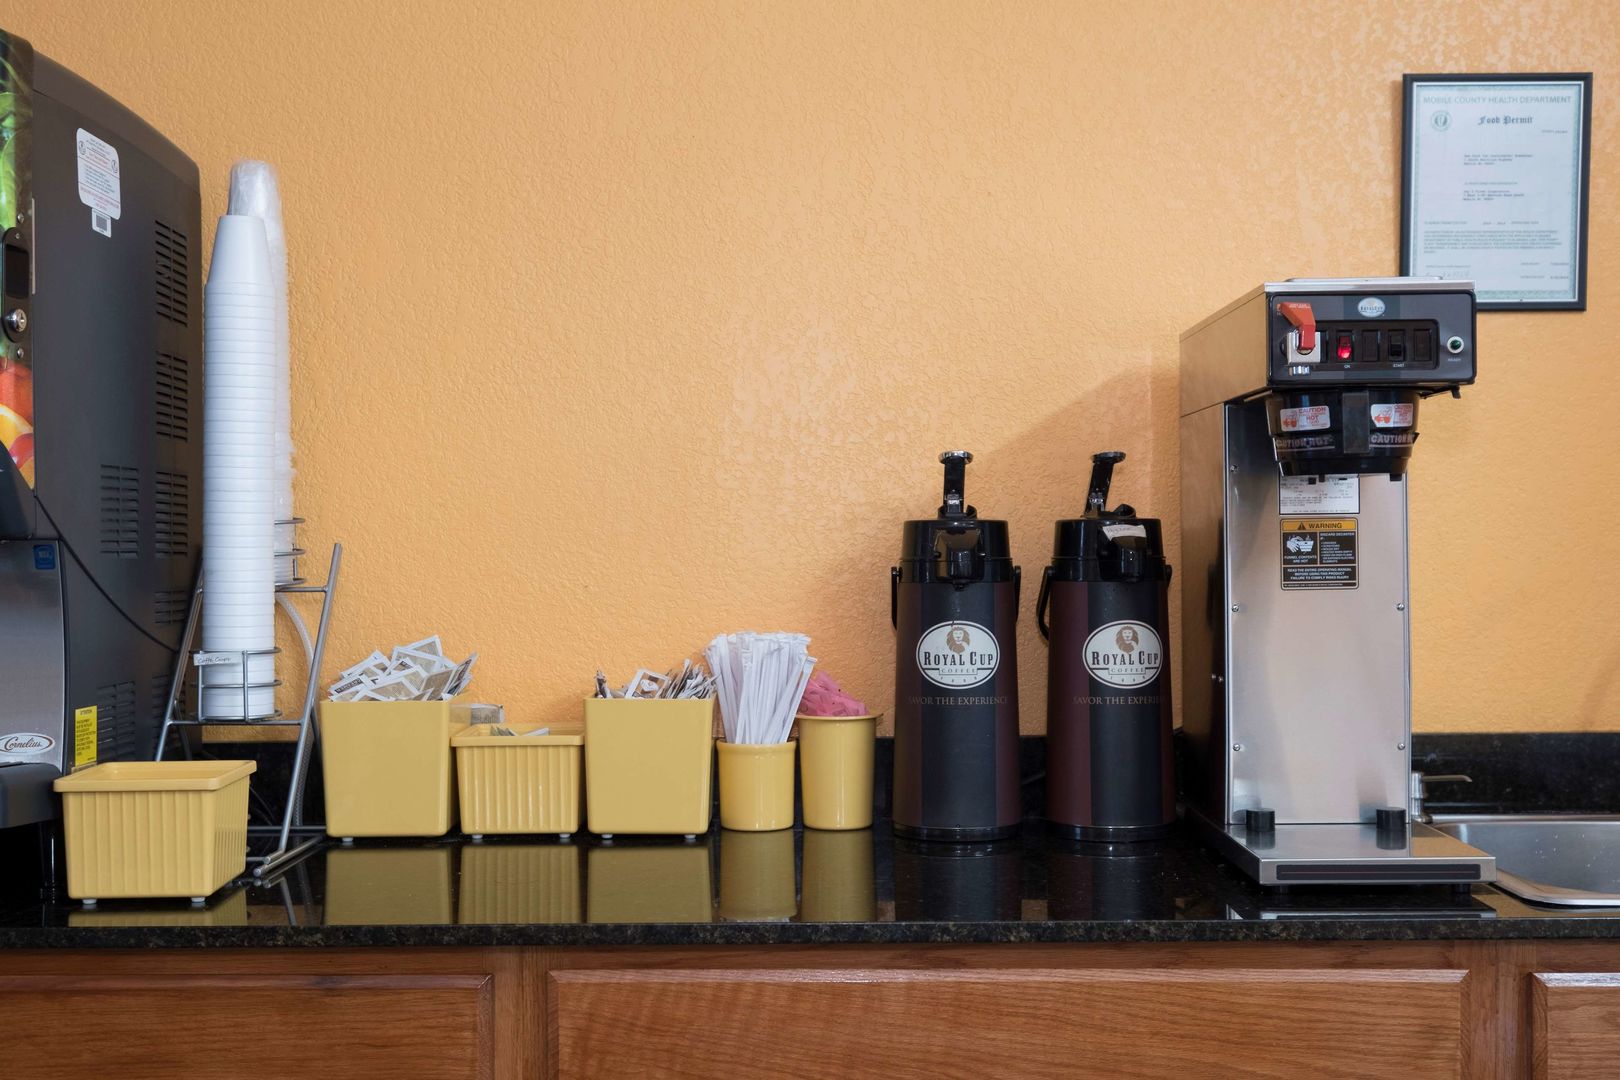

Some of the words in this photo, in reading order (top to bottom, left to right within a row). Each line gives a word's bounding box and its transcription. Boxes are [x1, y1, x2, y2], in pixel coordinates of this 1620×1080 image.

[1455, 95, 1487, 104] COUNTY
[1489, 95, 1518, 104] HEALTH
[1520, 95, 1571, 104] DEPARTMENT
[1478, 115, 1500, 125] Food
[1503, 115, 1533, 125] Permit
[924, 652, 965, 666] ROYAL
[970, 652, 994, 666] CUP
[1092, 651, 1134, 666] ROYAL
[1138, 651, 1158, 665] CUP
[935, 696, 954, 705] THE
[1104, 696, 1125, 705] THE
[4, 736, 41, 752] Cornelius
